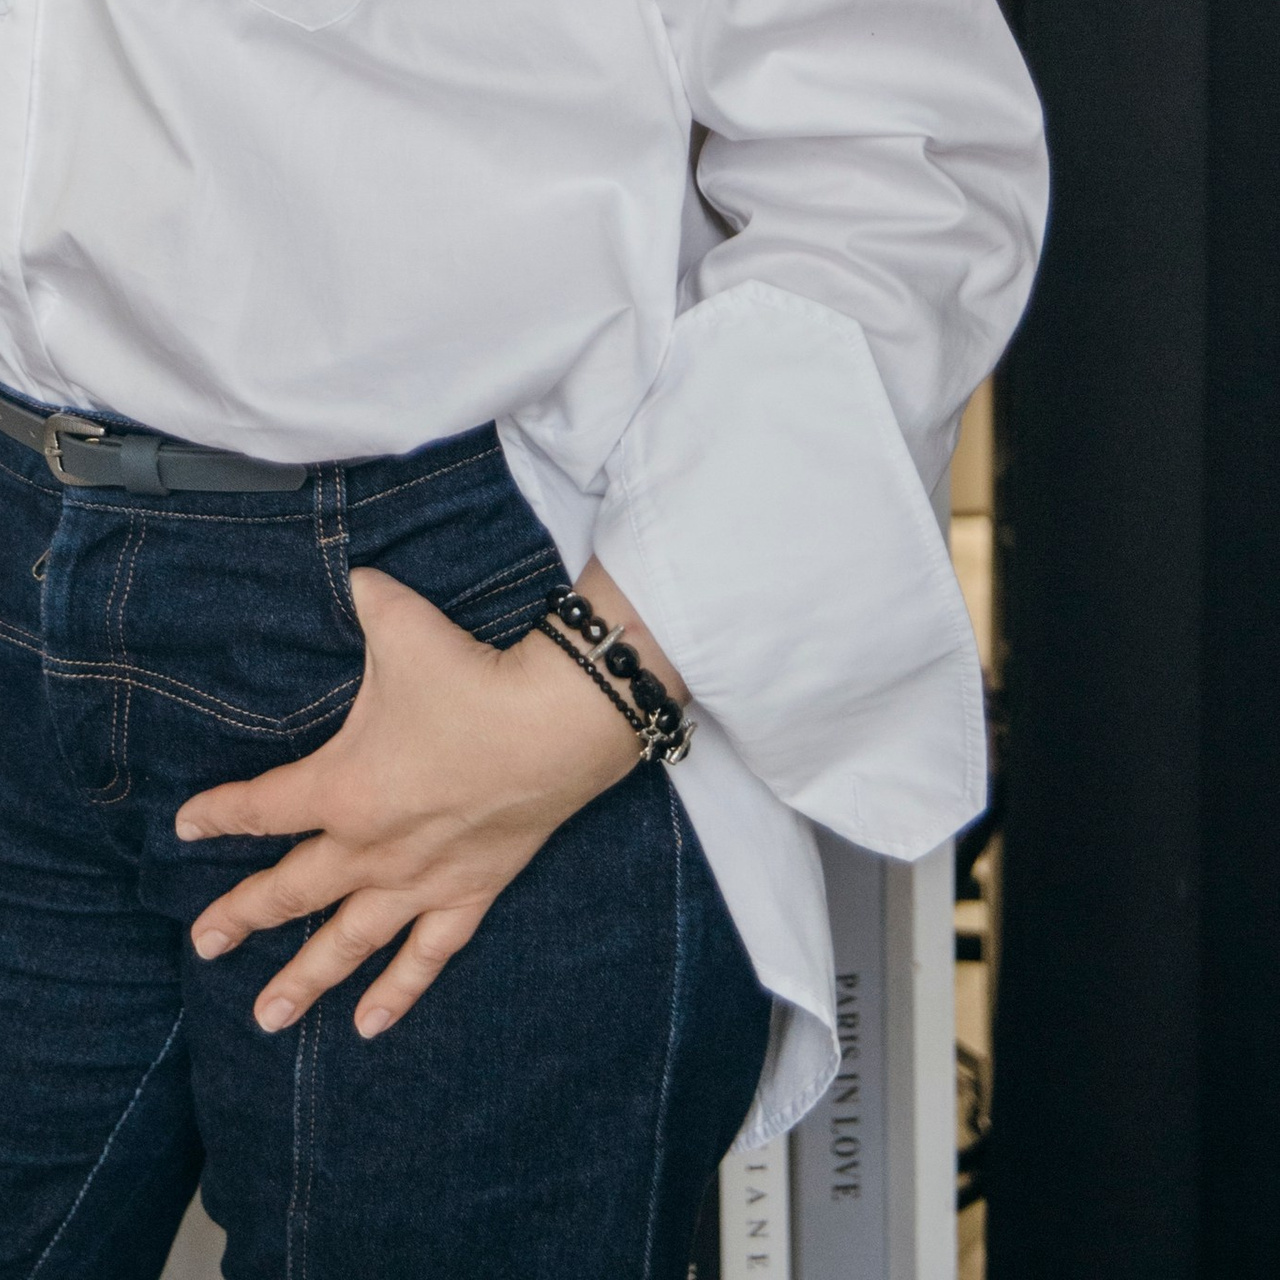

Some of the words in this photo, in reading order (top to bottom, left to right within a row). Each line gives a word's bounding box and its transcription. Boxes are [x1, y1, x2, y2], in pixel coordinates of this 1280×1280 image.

[835, 973, 860, 1062] PARIS
[833, 1072, 860, 1106] IN
[830, 1115, 861, 1202] LOVE
[744, 1142, 770, 1270] IANE
